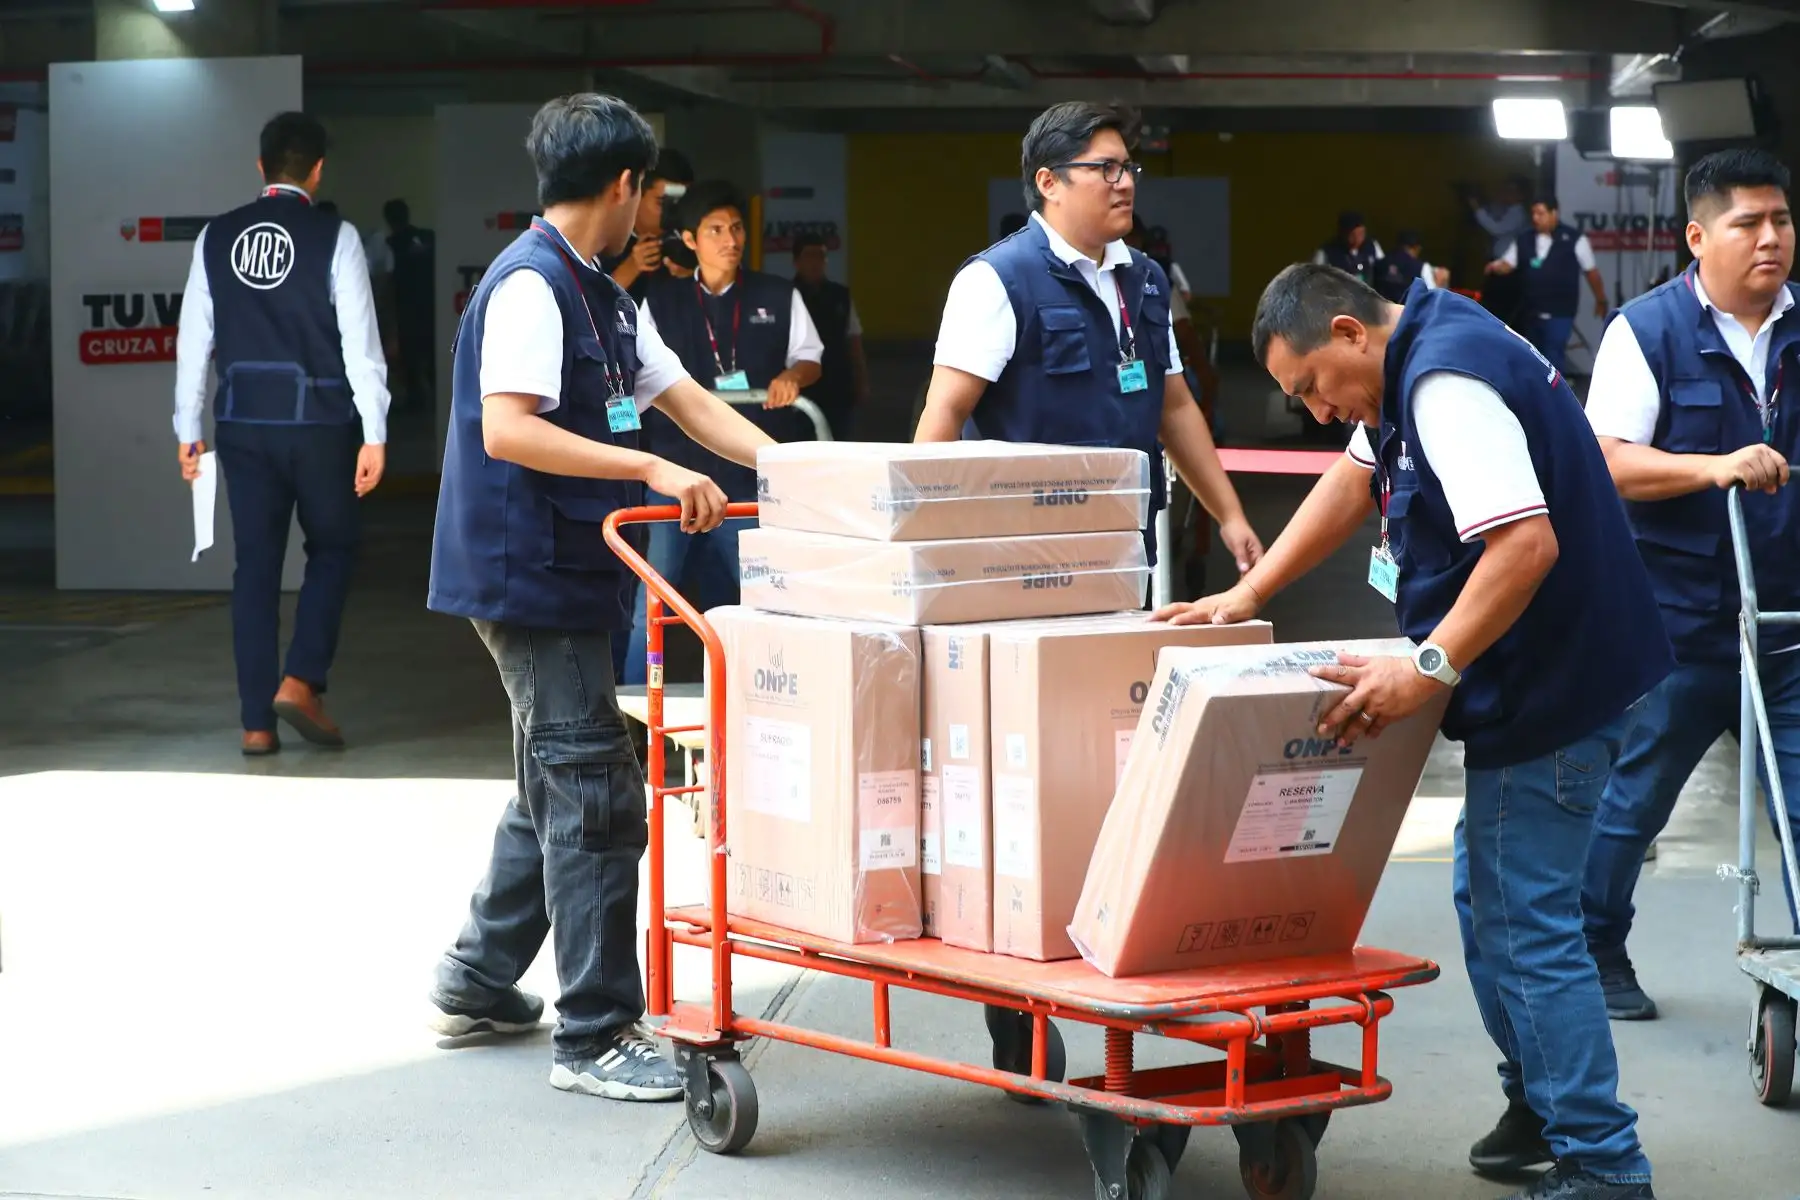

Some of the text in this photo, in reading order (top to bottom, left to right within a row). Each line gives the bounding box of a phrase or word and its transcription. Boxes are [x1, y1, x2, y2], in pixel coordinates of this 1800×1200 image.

[237, 231, 288, 280] MRE
[82, 293, 145, 328] TU
[88, 337, 157, 357] CRUZA
[1032, 488, 1089, 507] ONPE
[1022, 571, 1074, 590] ONPE
[755, 668, 798, 695] ONPE
[1152, 667, 1180, 734] ONPE
[1279, 784, 1325, 797] RESERVA
